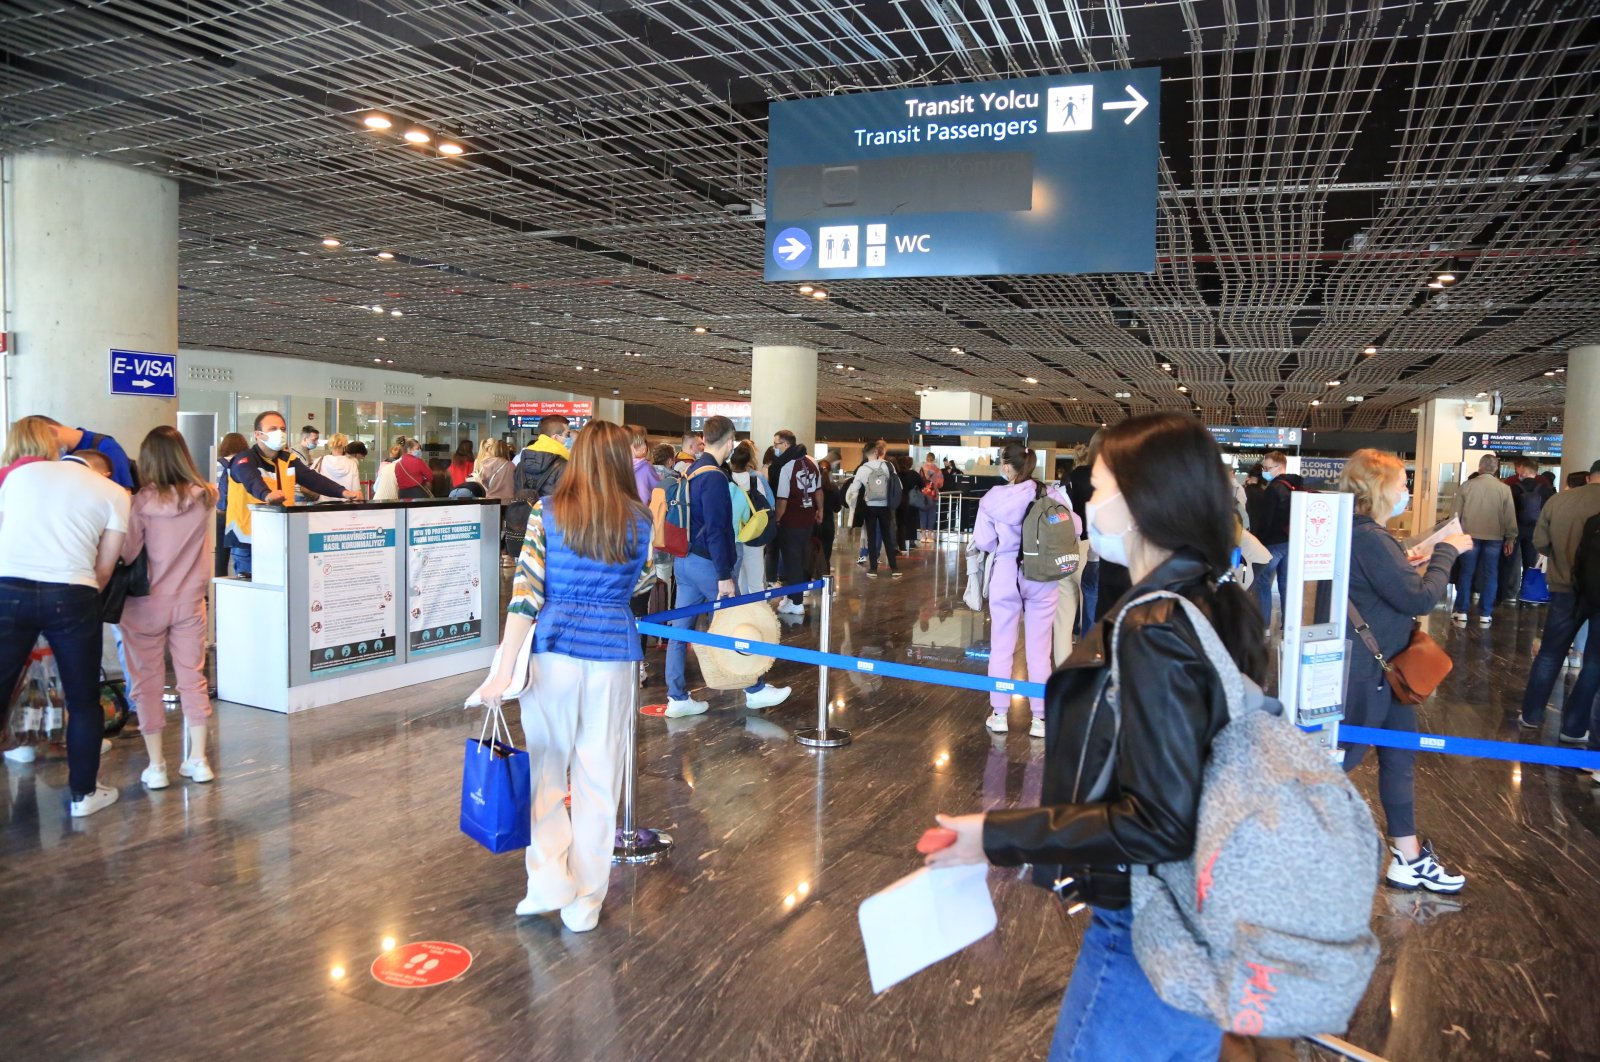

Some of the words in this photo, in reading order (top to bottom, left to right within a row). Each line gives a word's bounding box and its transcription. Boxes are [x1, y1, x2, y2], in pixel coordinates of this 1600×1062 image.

[905, 94, 975, 118] Transit
[980, 89, 1039, 112] Yolcu
[854, 125, 921, 147] Transit
[927, 119, 1038, 142] Passengers
[894, 234, 931, 253] WC
[113, 357, 174, 378] E-VISA
[511, 417, 516, 426] 1
[695, 419, 700, 428] 3
[915, 422, 922, 432] 5
[1016, 424, 1023, 434] 6
[1288, 431, 1296, 441] 8
[1468, 436, 1477, 446] 9
[1300, 468, 1343, 478] ODRUM
[323, 543, 340, 551] NASIL
